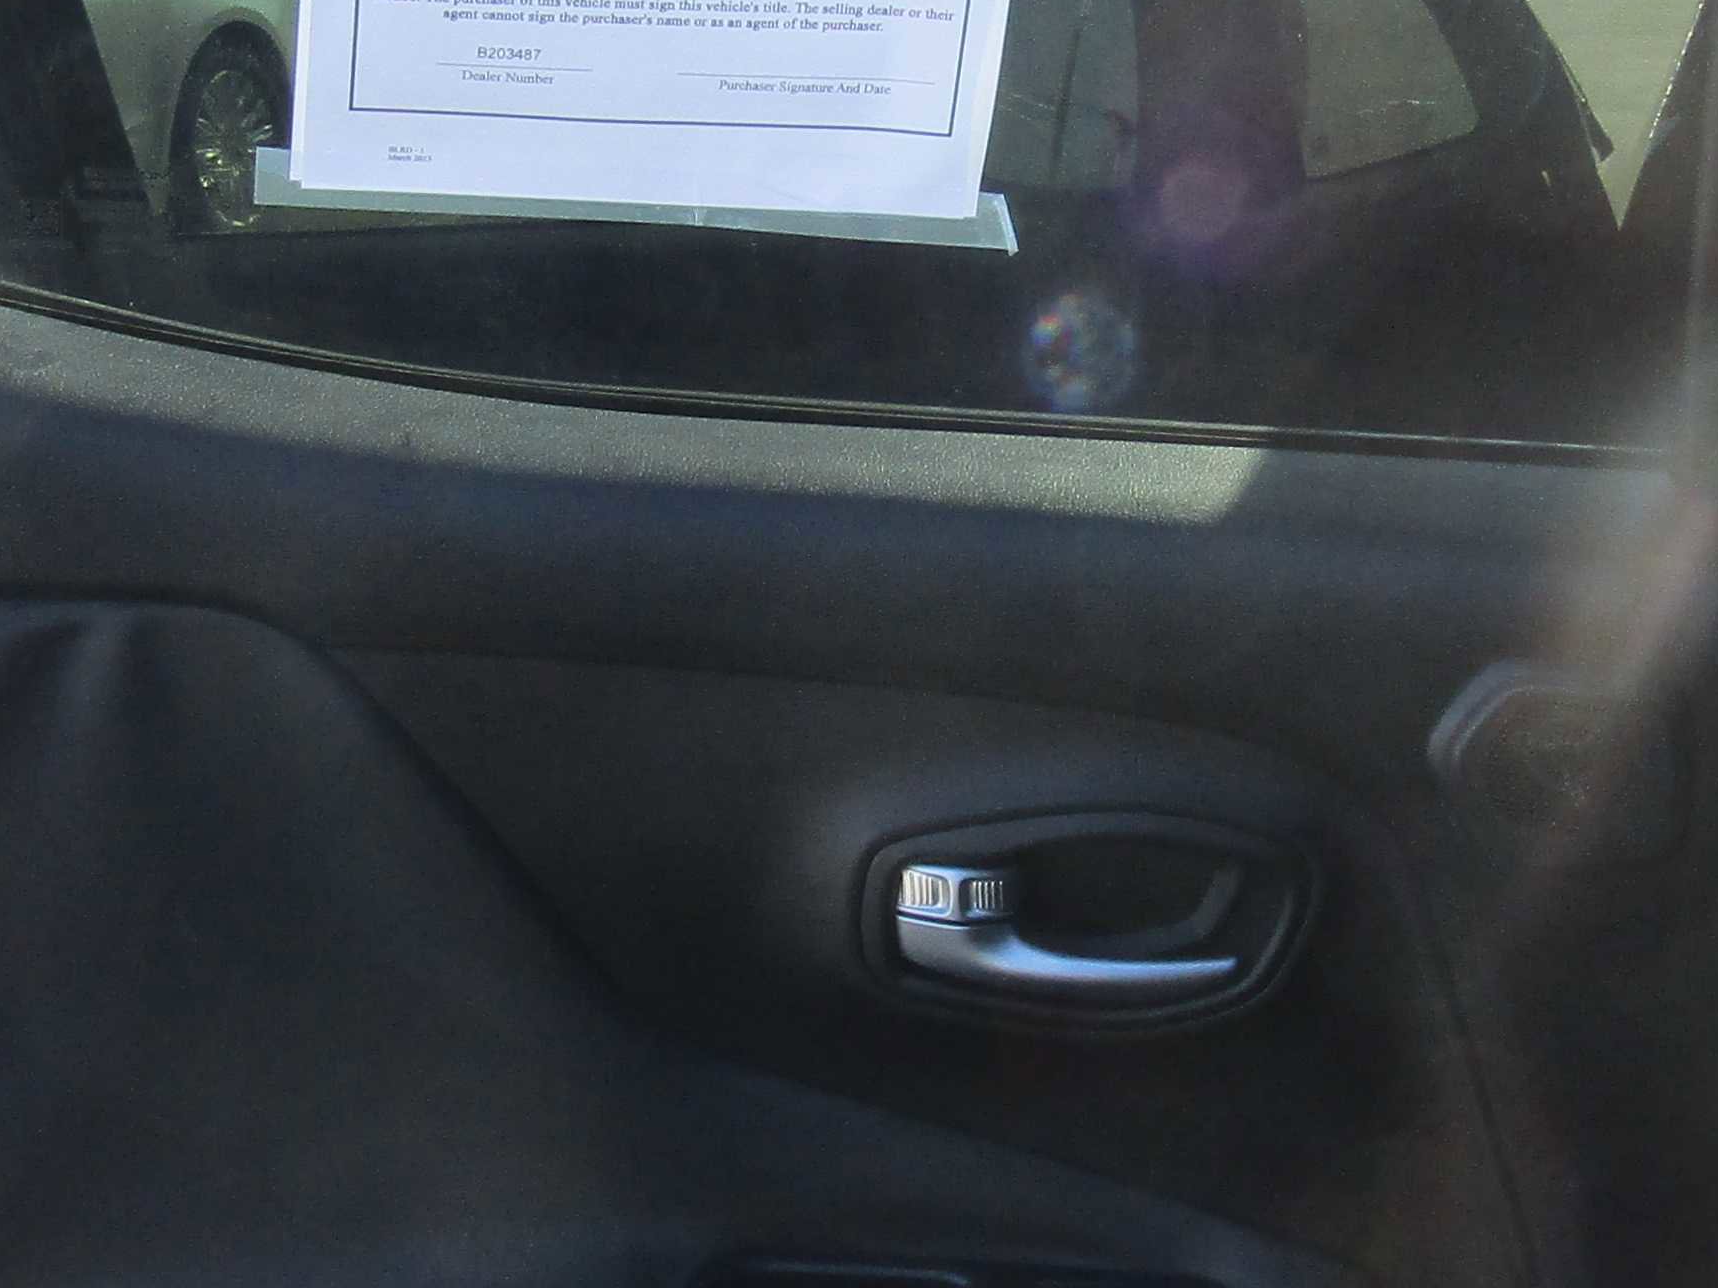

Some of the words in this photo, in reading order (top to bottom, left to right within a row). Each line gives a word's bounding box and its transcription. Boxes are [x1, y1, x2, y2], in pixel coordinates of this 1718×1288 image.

[679, 0, 701, 11] this
[795, 3, 818, 15] The
[821, 4, 863, 21] selling
[867, 6, 904, 19] dealer
[908, 10, 923, 19] or
[925, 8, 954, 21] their
[443, 8, 477, 24] agent
[481, 9, 524, 22] cannot
[527, 10, 555, 26] sign
[559, 11, 579, 23] the
[656, 16, 690, 26] name
[694, 17, 708, 26] or
[711, 17, 723, 27] as
[727, 18, 741, 27] an
[746, 16, 779, 32] agent
[783, 17, 797, 29] of
[799, 17, 818, 29] the
[477, 46, 541, 61] B203487
[462, 69, 503, 82] Dealer
[505, 70, 554, 84] Number
[719, 79, 777, 91] Purchaser
[779, 80, 833, 96] Signature
[837, 81, 860, 93] And
[864, 82, 891, 94] Date
